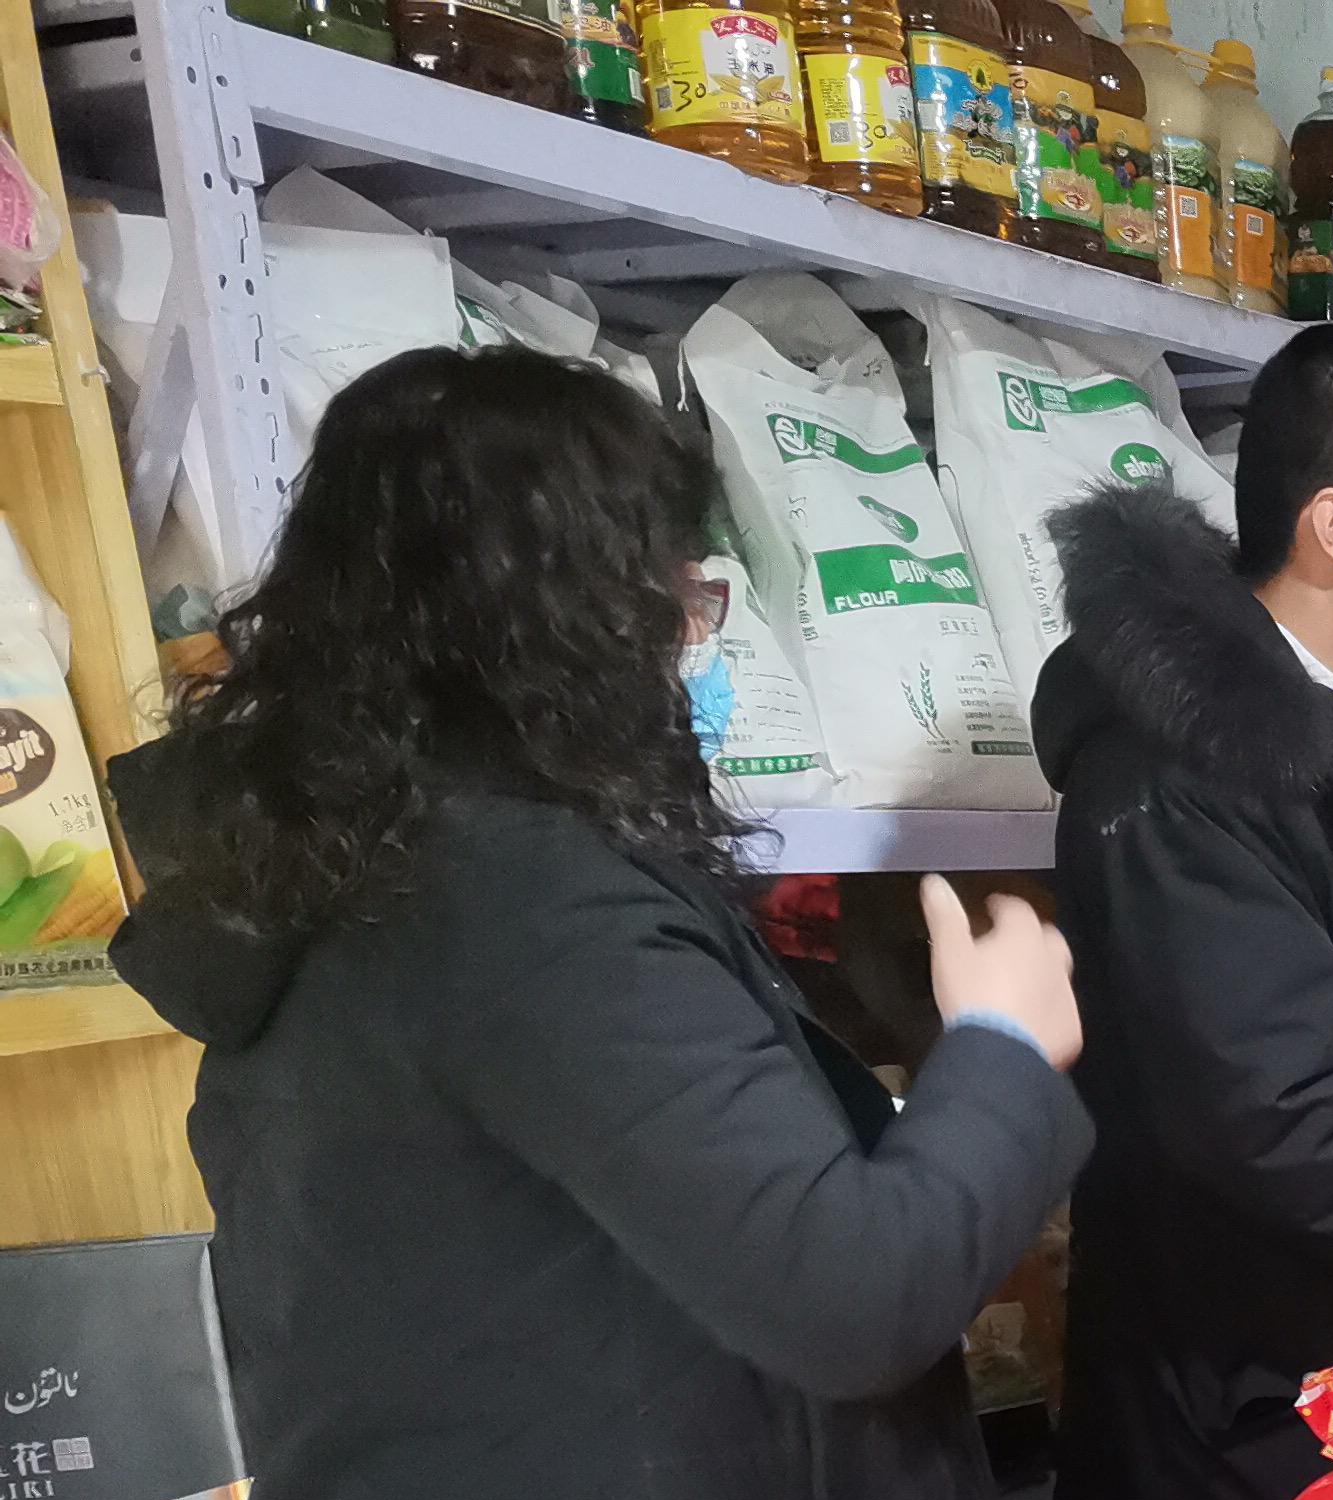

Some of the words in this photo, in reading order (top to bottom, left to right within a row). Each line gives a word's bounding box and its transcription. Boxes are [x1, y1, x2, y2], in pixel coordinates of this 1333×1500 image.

[672, 80, 707, 112] 30
[833, 590, 900, 611] FLOUR
[49, 794, 92, 819] 1.7kg
[8, 1440, 52, 1478] 花
